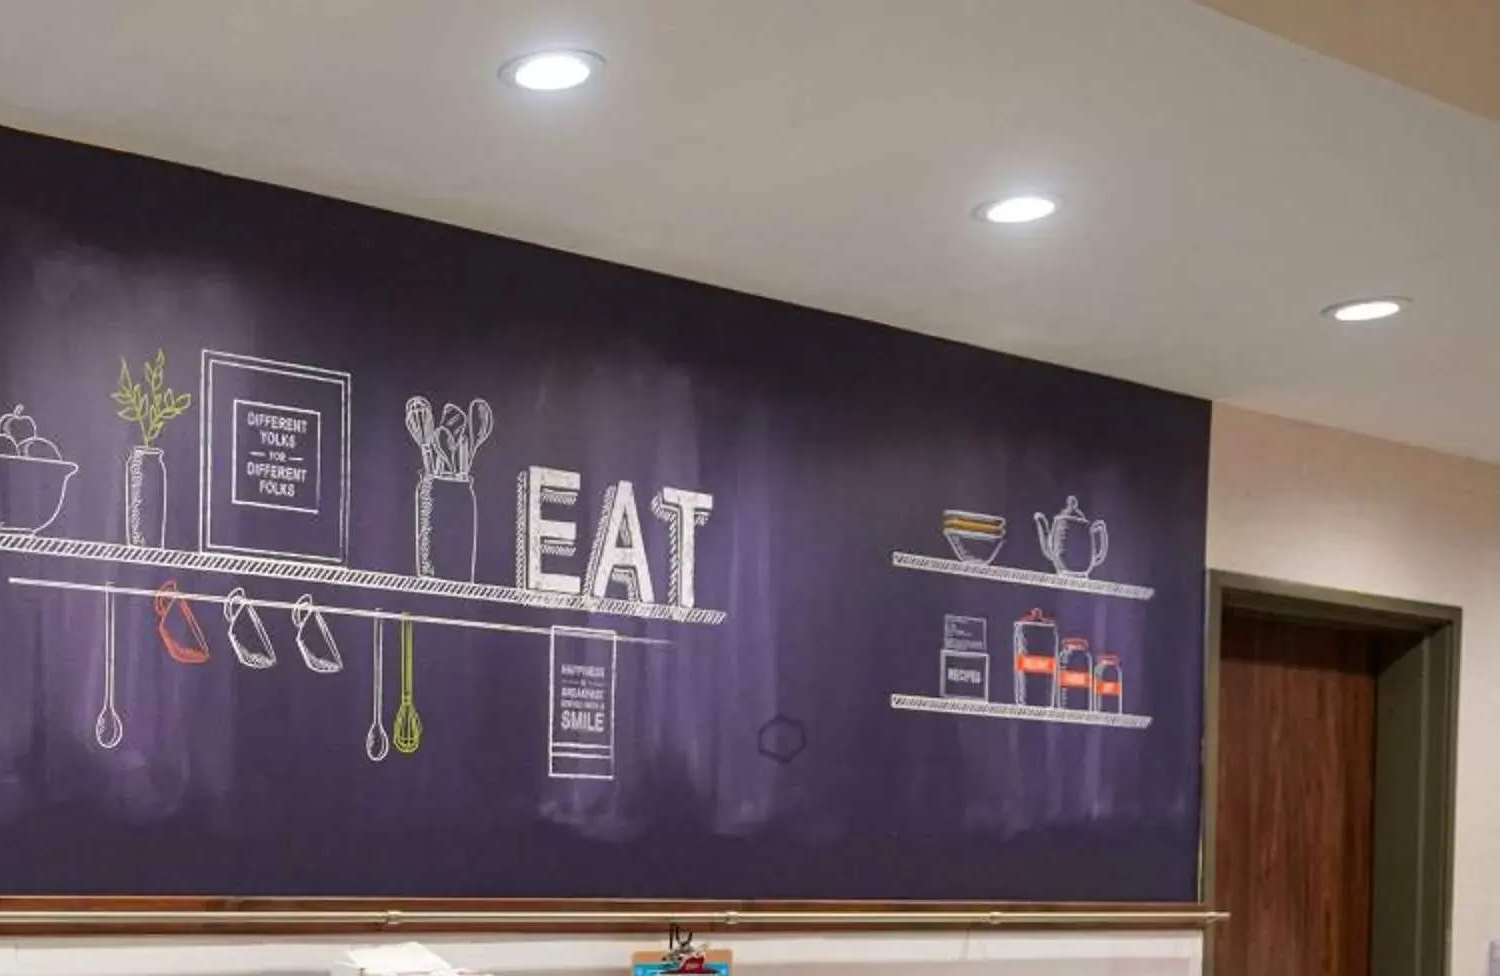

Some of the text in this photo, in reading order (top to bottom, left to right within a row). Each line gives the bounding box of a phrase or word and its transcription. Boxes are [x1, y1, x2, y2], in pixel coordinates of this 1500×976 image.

[247, 411, 308, 433] DIFFERENT
[260, 430, 296, 449] YOLKS
[247, 461, 308, 483] DIFFERENT
[259, 480, 296, 497] FOLKS
[516, 466, 714, 609] EAT
[561, 709, 605, 732] SMILE
